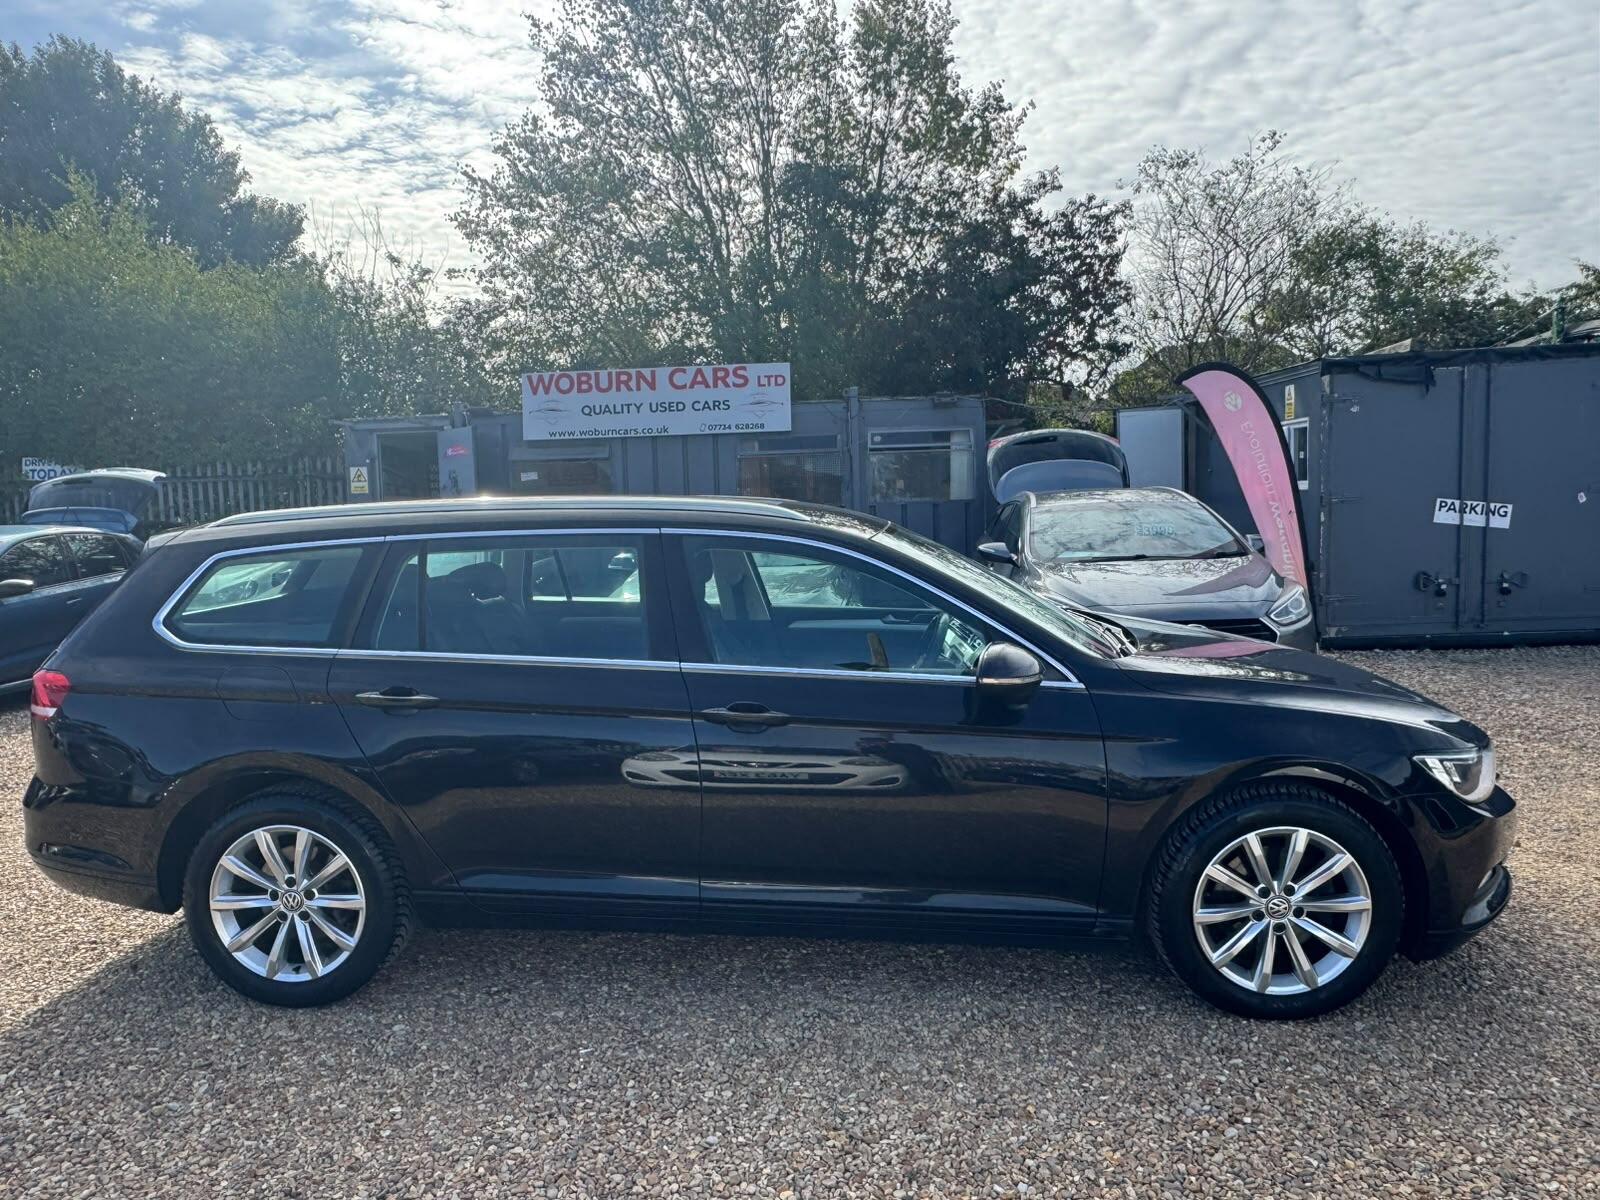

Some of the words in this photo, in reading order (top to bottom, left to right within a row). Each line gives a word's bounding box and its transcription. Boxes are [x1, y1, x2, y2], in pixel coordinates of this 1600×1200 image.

[526, 370, 657, 396] WOBURN
[668, 365, 749, 390] CARS
[756, 374, 786, 387] LTD
[581, 402, 643, 416] QUALITY
[649, 401, 686, 413] USED
[691, 400, 731, 411] CARS
[548, 425, 669, 438] www.woburncars.co.uk
[707, 423, 732, 431] 07734
[24, 458, 51, 467] DRIV
[1438, 500, 1509, 518] PARKING
